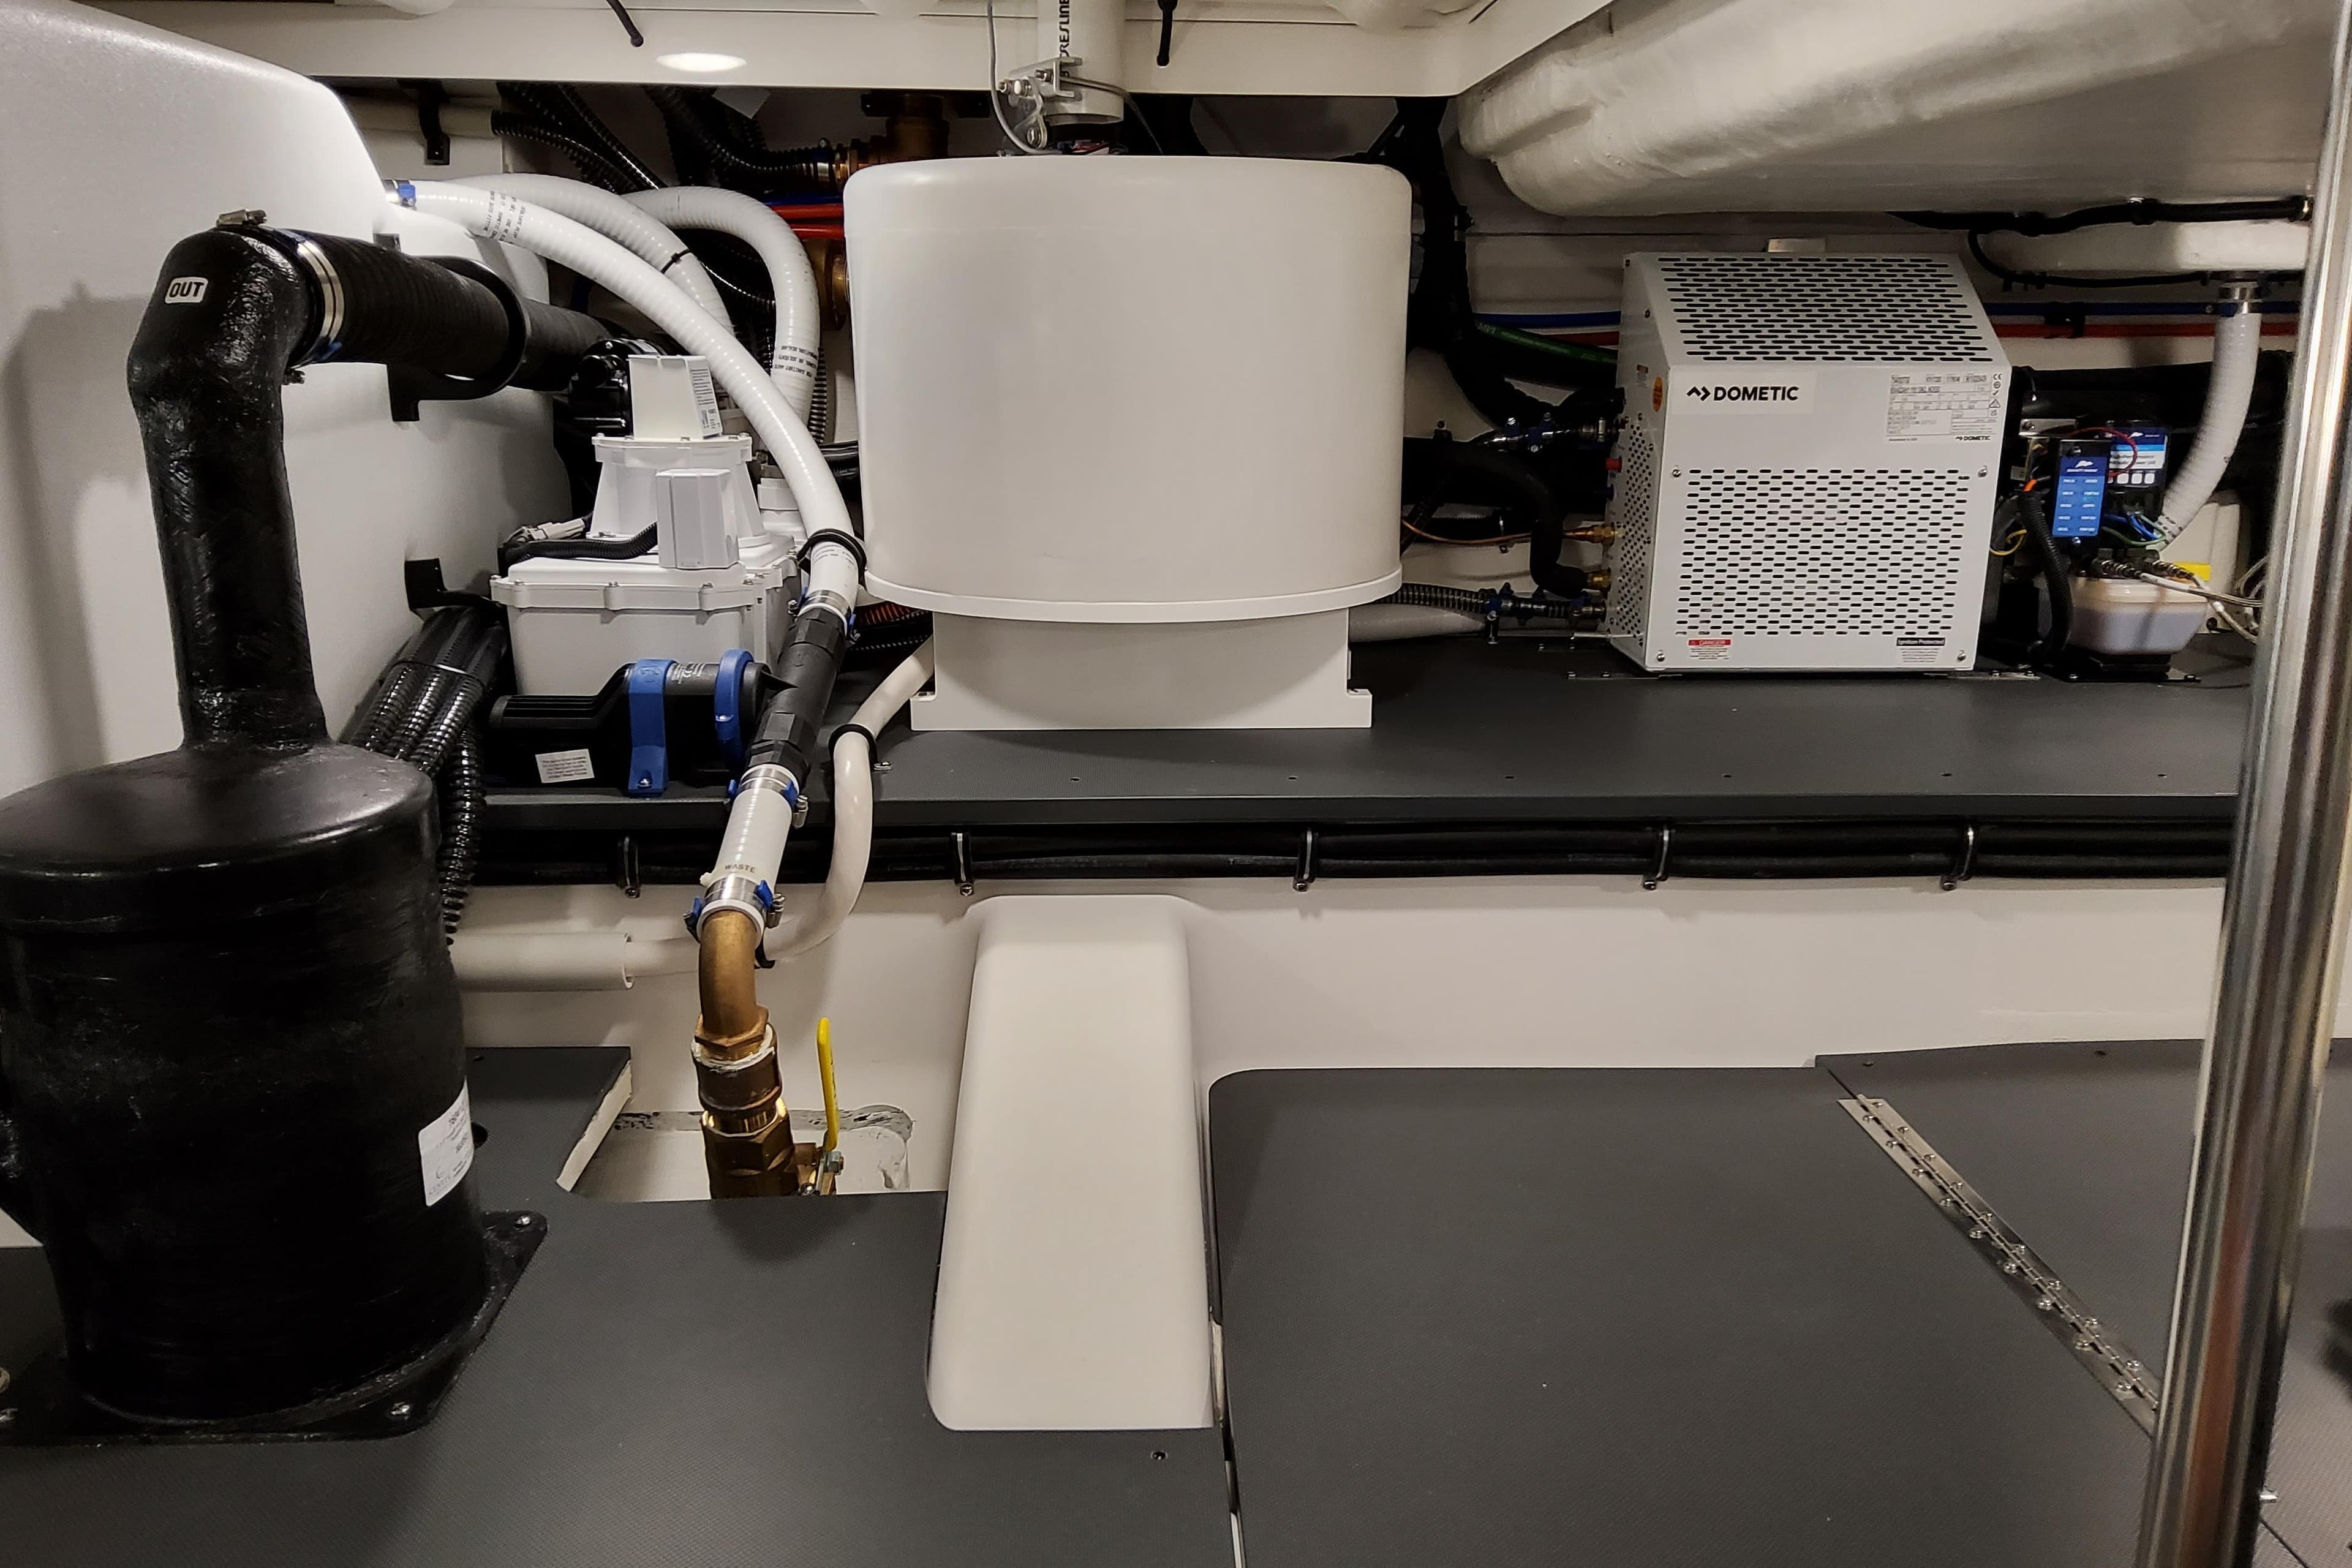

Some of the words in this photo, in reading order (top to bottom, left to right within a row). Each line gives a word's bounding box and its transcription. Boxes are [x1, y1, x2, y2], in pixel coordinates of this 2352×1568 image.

[1059, 0, 1070, 58] RESLINE
[169, 281, 205, 298] OUT
[1713, 386, 1800, 401] DOMETIC
[725, 864, 755, 873] WASTE
